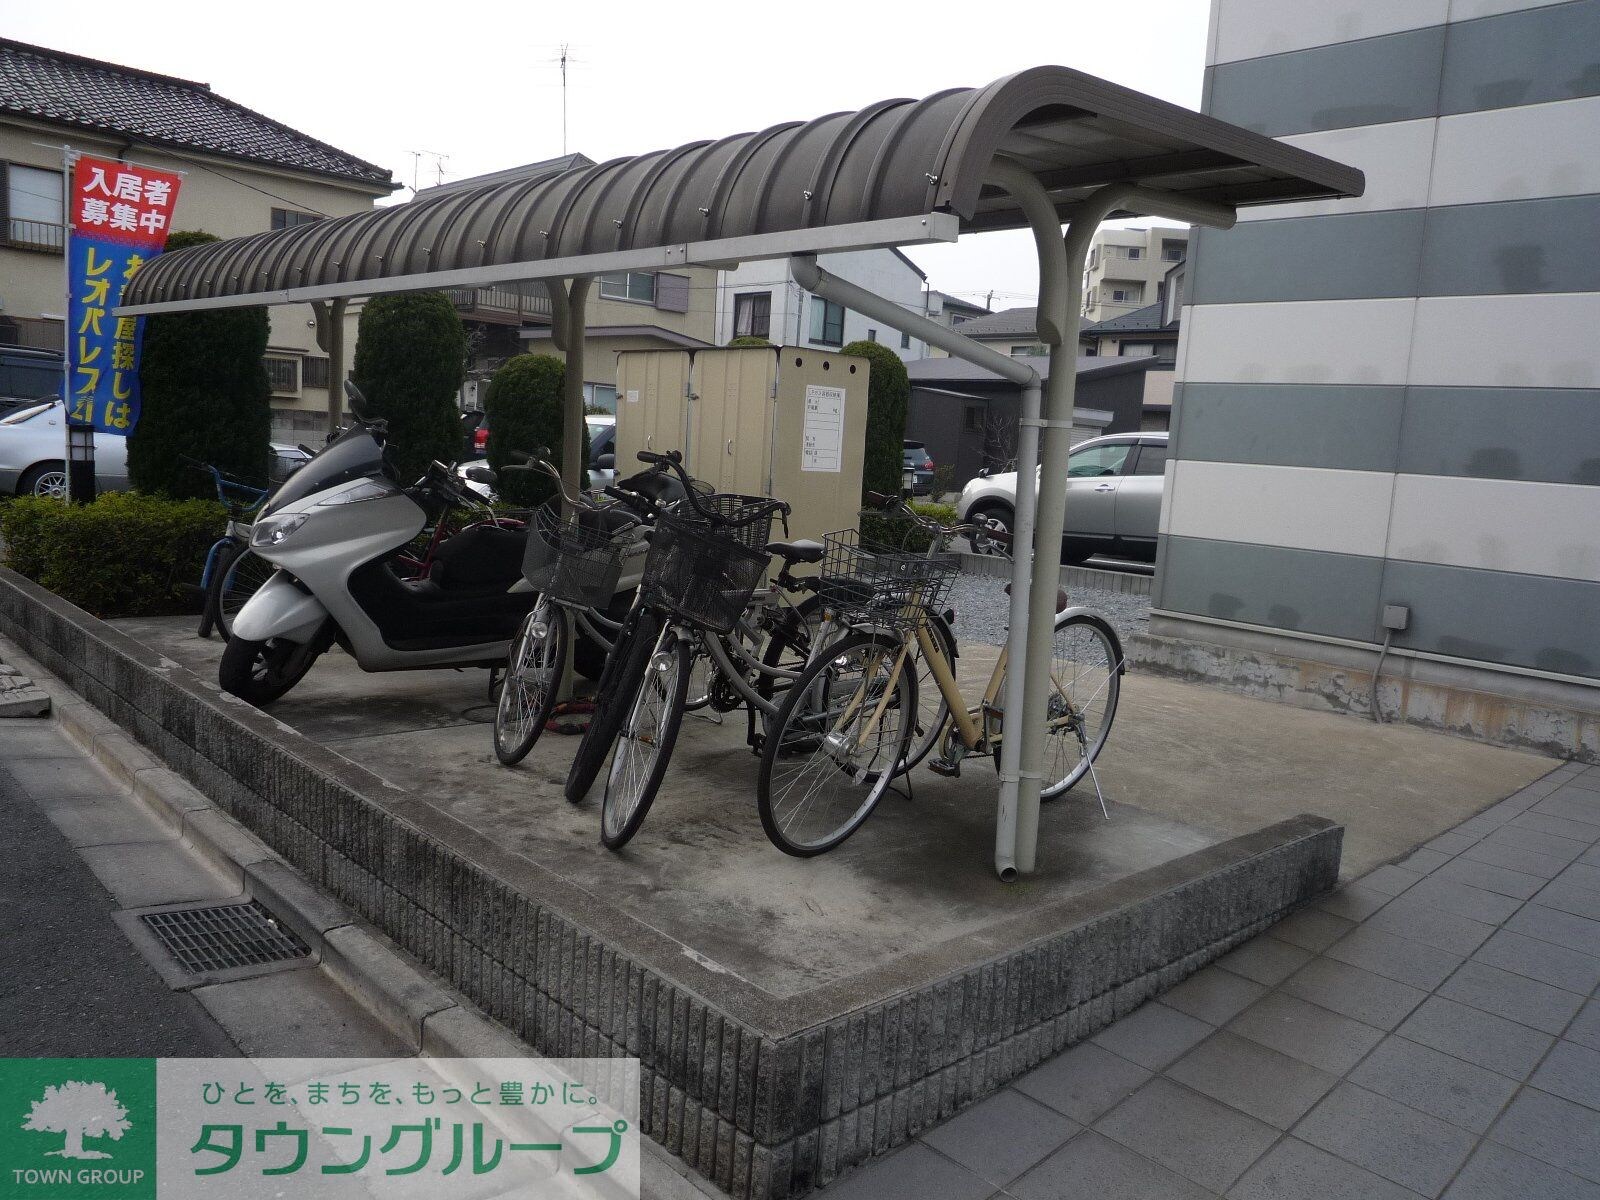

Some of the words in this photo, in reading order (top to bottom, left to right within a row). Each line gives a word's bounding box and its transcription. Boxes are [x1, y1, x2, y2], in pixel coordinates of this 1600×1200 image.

[83, 167, 172, 206] 入居者
[81, 198, 166, 235] 募集中
